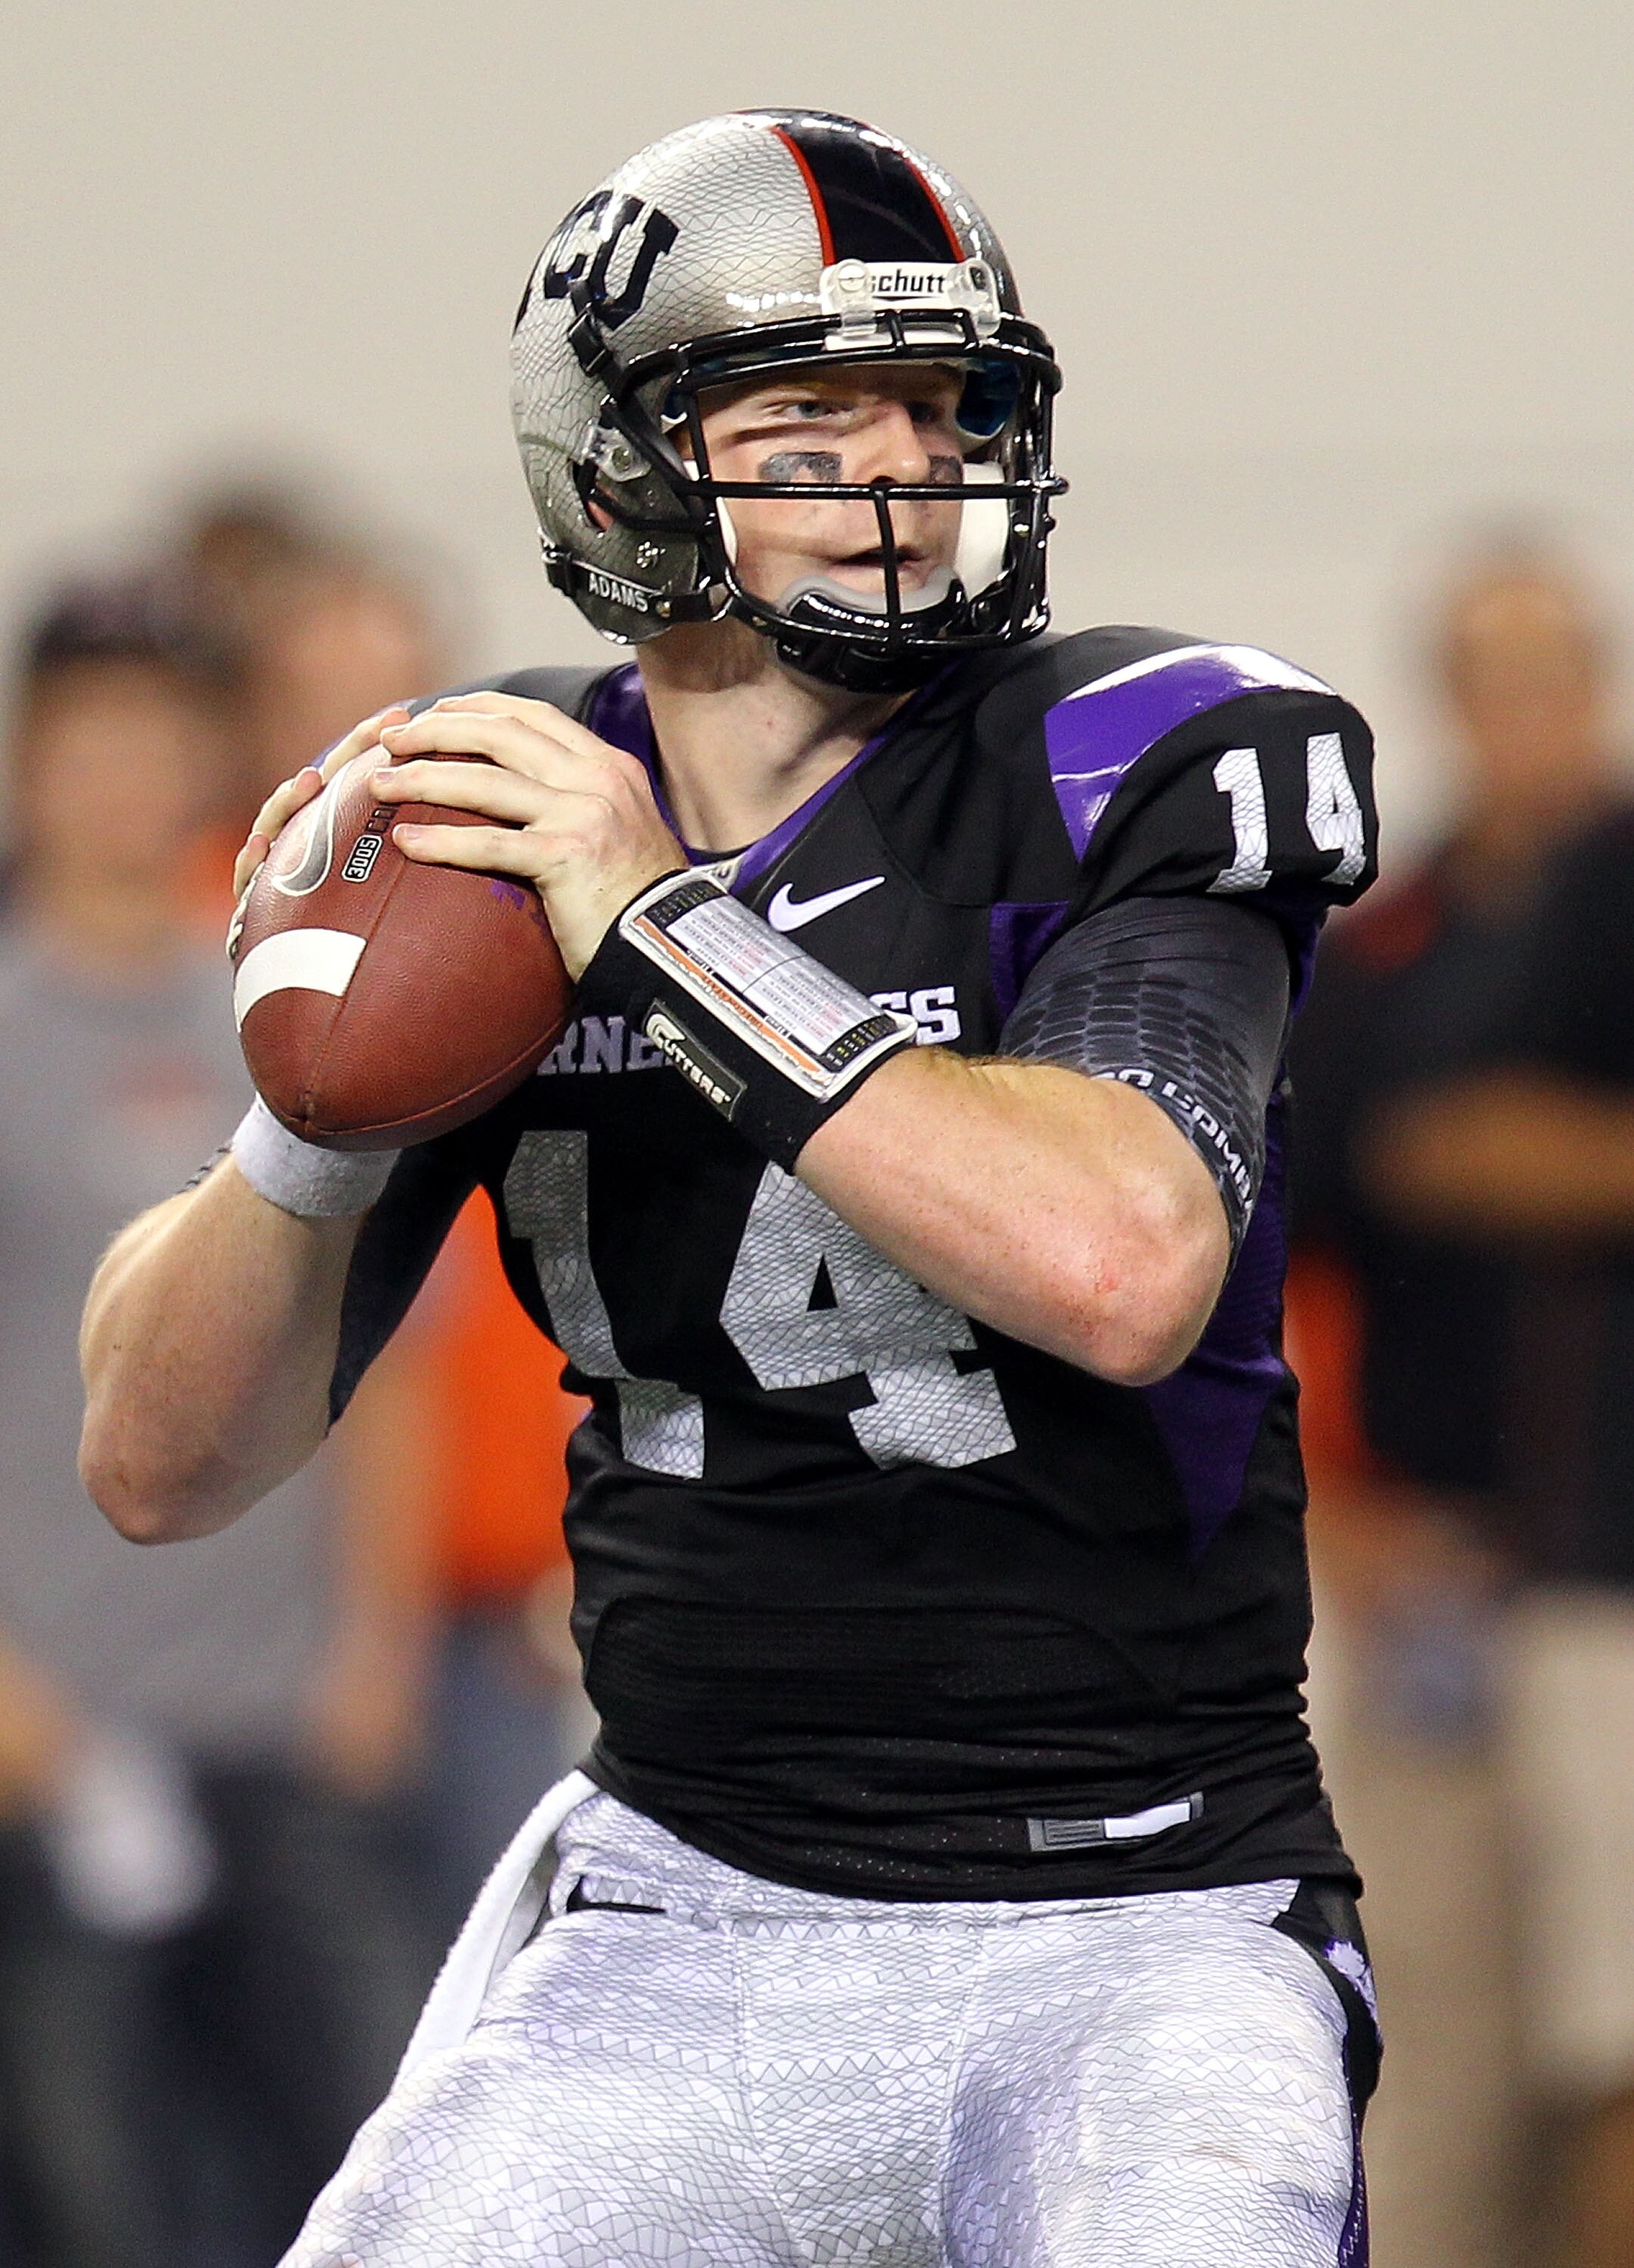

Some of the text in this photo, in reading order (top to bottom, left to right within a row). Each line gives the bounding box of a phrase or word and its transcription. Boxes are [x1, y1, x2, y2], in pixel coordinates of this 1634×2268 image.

[512, 190, 679, 339] CU
[588, 572, 649, 612] ADAMS
[347, 838, 377, 878] 3005
[1206, 731, 1366, 892] 14
[503, 1130, 1018, 1480] 14
